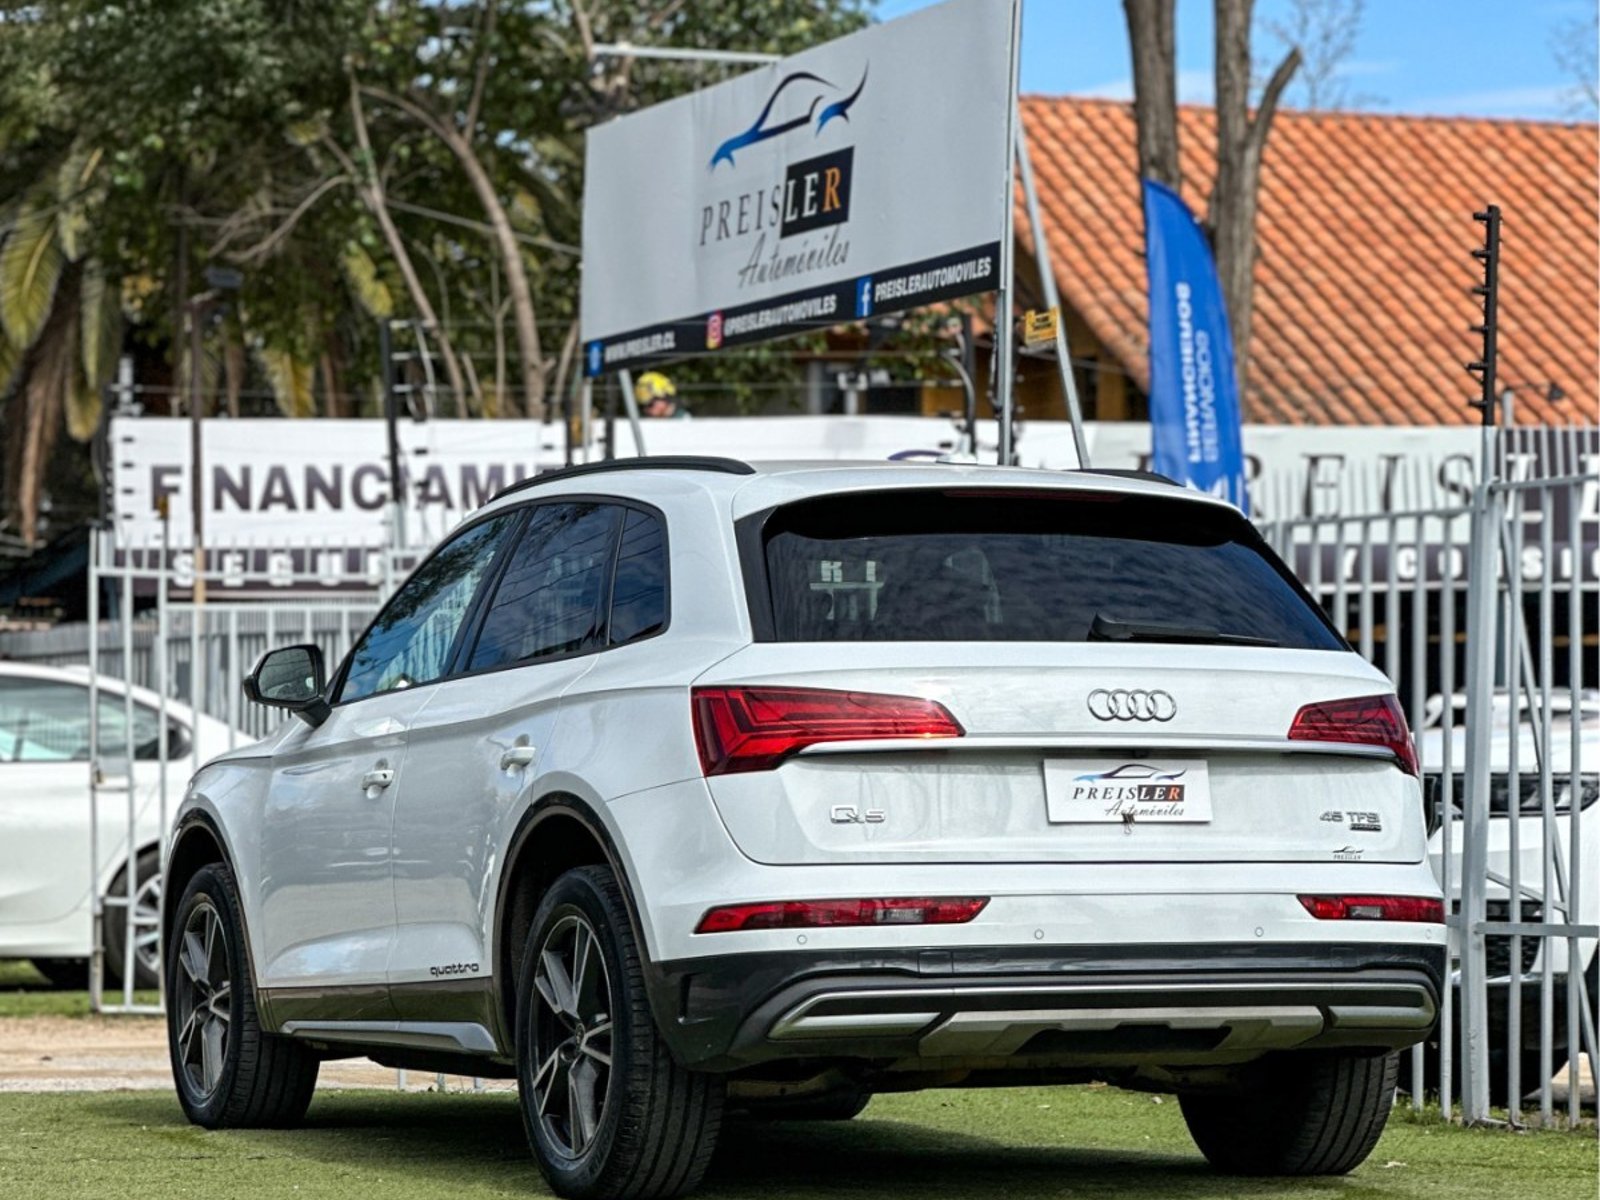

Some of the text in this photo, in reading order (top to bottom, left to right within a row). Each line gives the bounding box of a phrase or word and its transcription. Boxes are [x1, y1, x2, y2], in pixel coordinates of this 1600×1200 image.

[699, 166, 842, 246] PREISLER
[874, 256, 993, 302] PREISLERAUTOMOVILES
[1072, 786, 1181, 801] PREISLER
[829, 804, 886, 824] Q5
[430, 963, 480, 977] quattro
